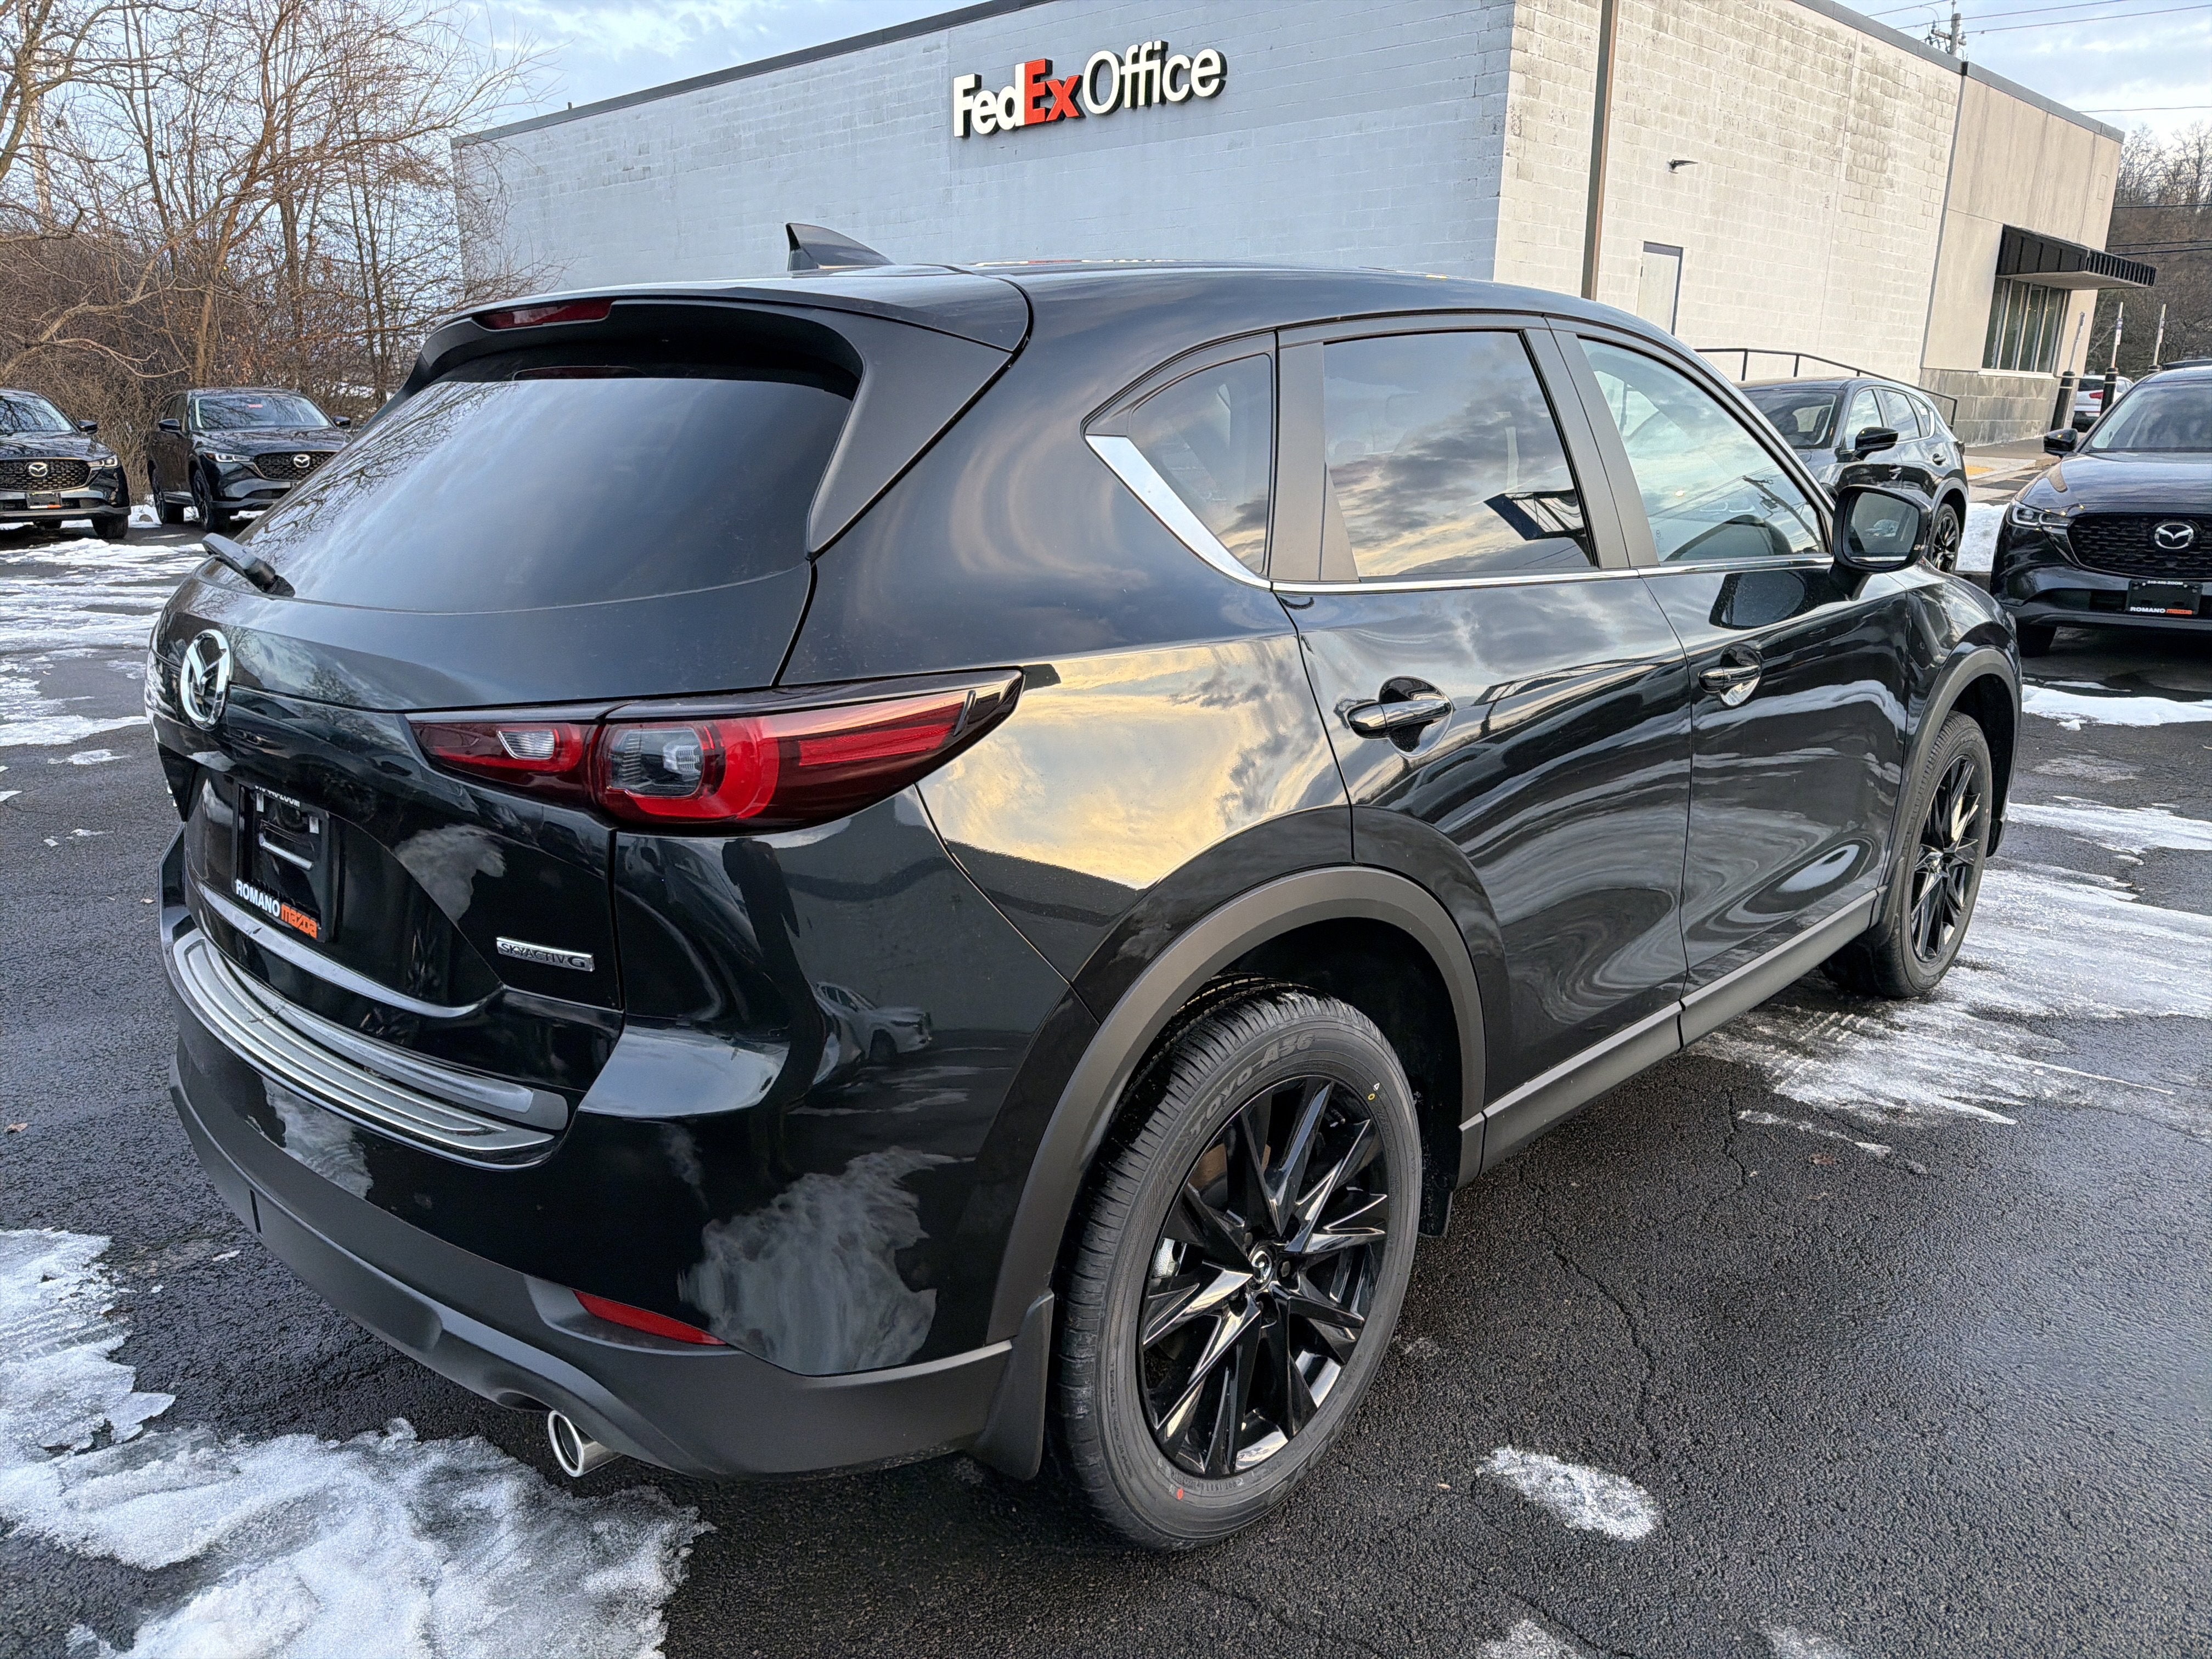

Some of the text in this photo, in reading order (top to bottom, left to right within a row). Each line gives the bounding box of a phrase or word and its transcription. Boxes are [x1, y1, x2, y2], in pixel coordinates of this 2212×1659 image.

[953, 40, 1225, 138] FedEx Office
[235, 879, 280, 917] ROMANO
[501, 943, 585, 968] SKYACTIV G
[1189, 1066, 1252, 1136] TOYO
